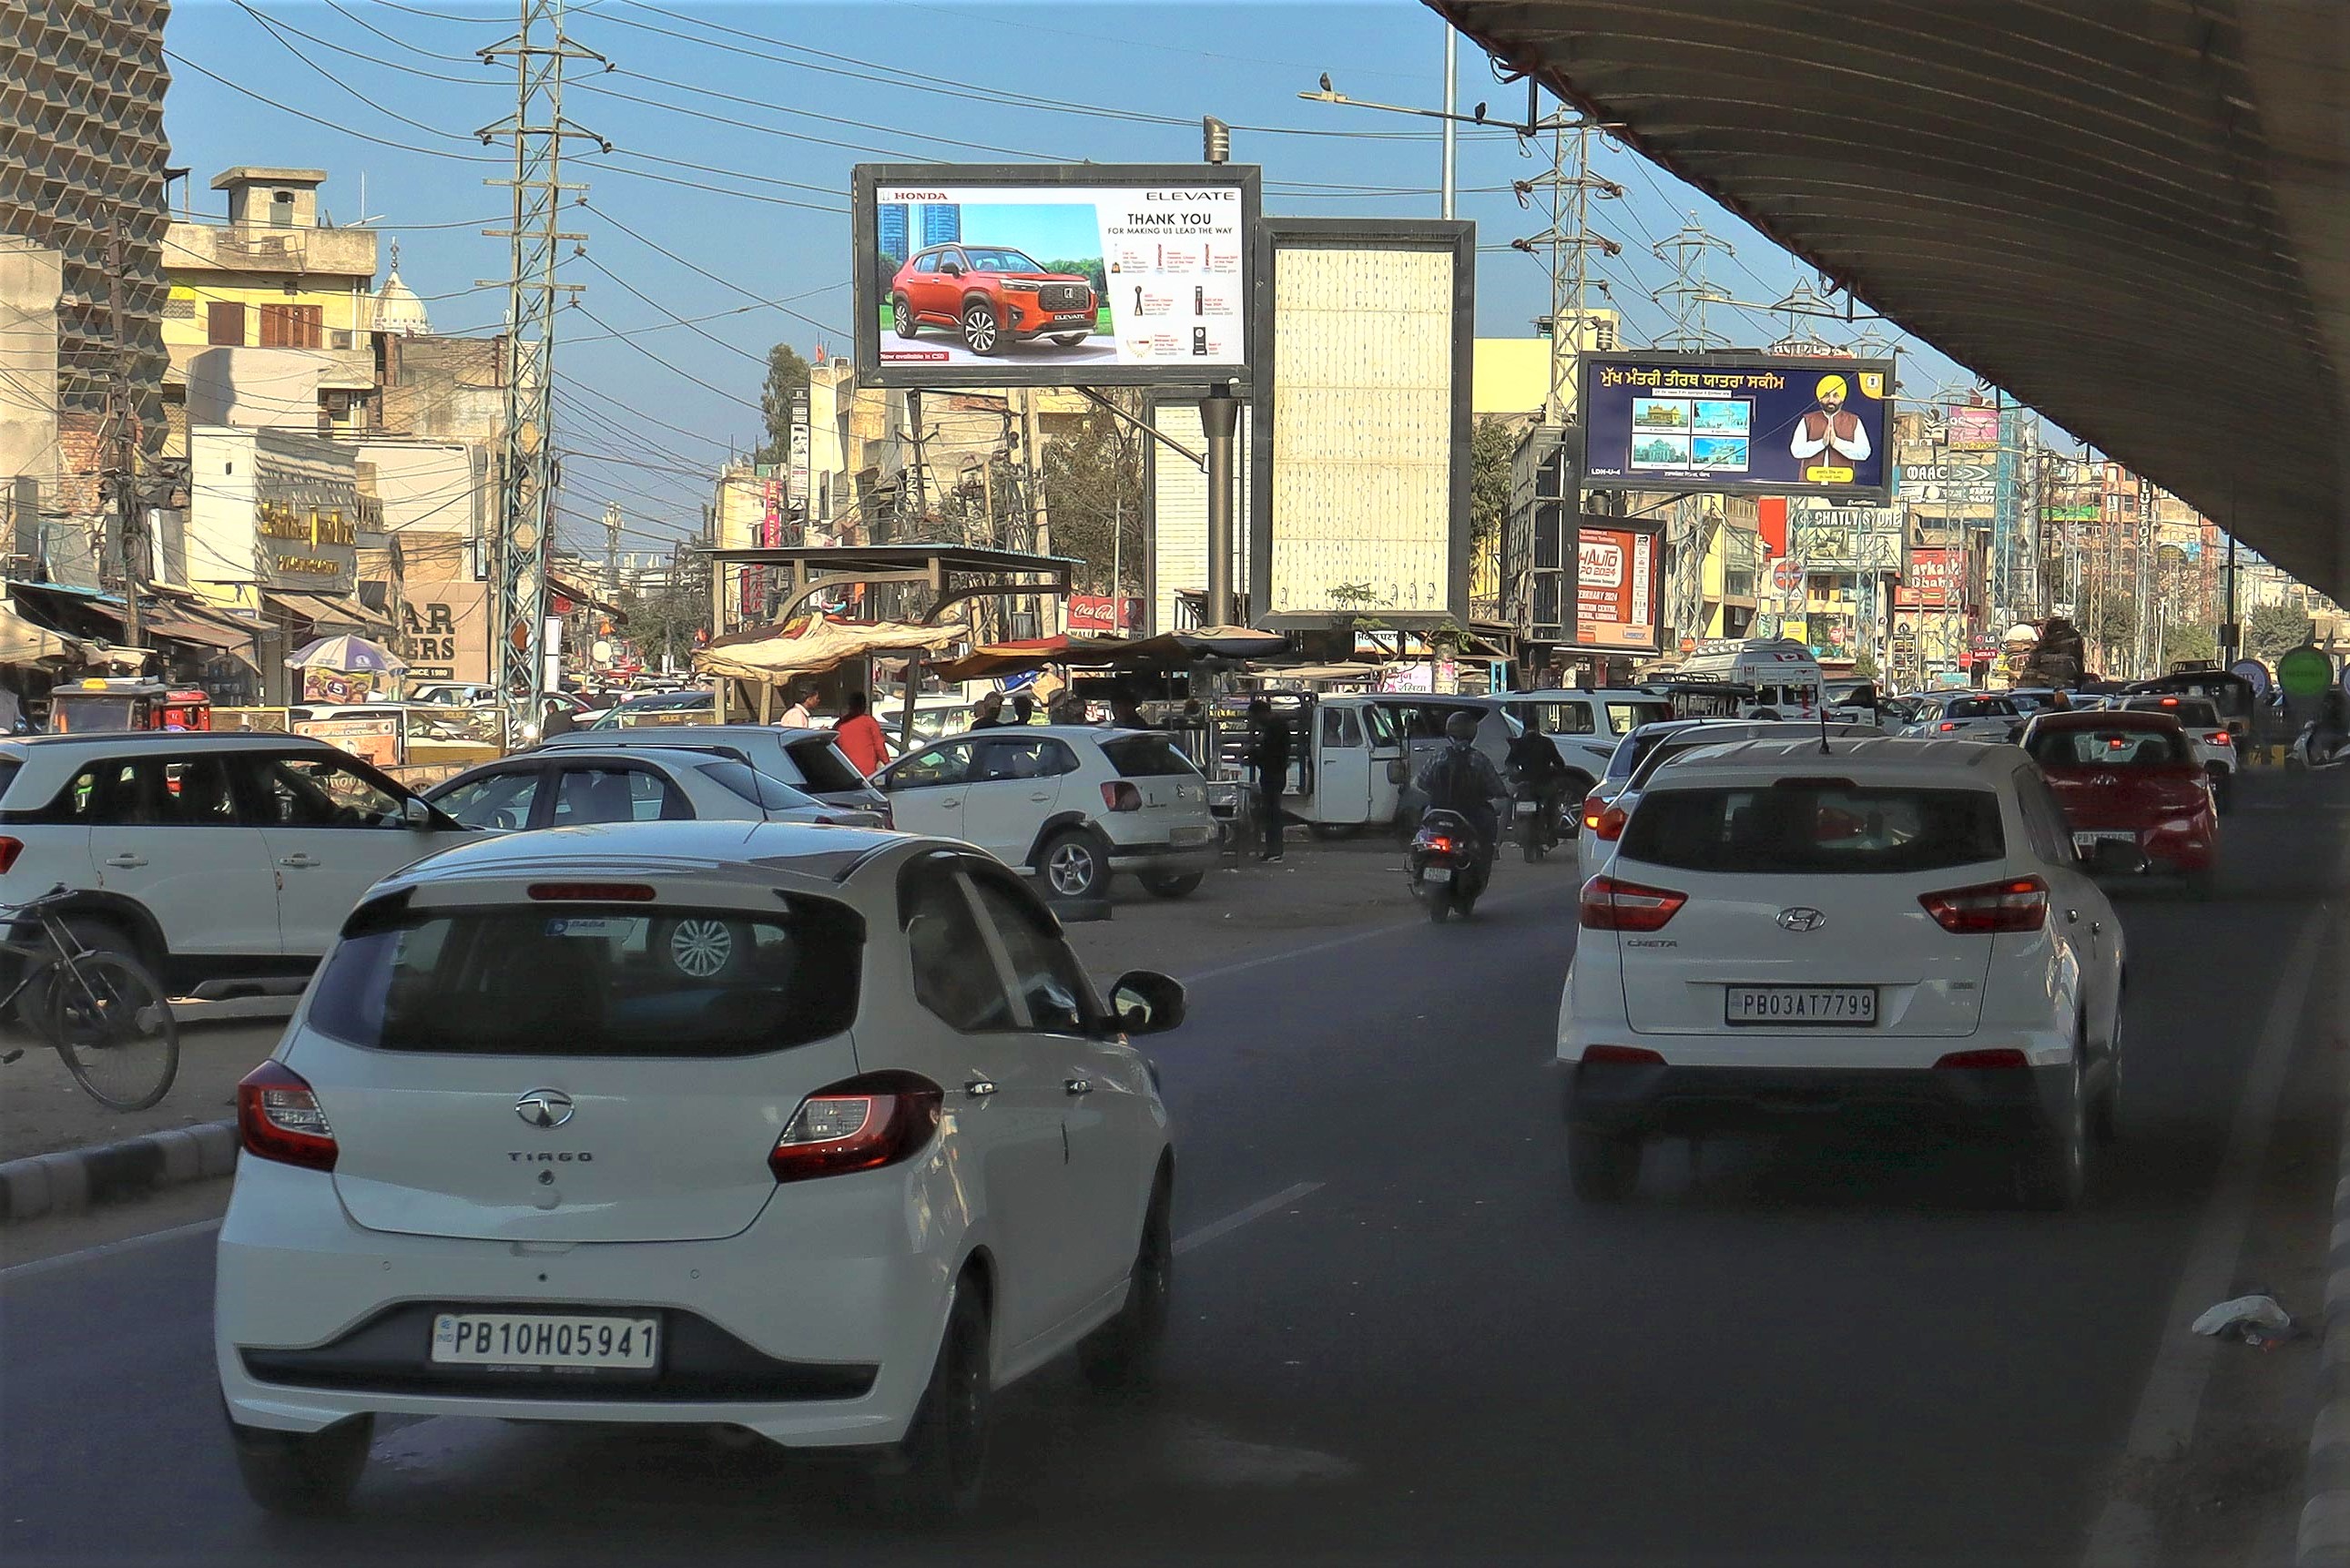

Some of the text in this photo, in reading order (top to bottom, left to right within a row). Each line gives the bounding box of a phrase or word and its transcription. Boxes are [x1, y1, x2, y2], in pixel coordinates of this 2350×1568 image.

[895, 192, 948, 200] HONDA
[1146, 191, 1236, 201] ELEVATE
[1127, 213, 1211, 225] THANK YOU
[1107, 227, 1124, 235] FOR
[1601, 367, 1785, 389] ਮੁੱਖ ਮੰਤਰੀ ਤੀਰਥ ਯਾਤਰਾ ਸਕੀਮ
[1907, 465, 1948, 481] MAAC
[1593, 567, 1616, 576] 2024
[1627, 940, 1678, 948] CRETA
[1744, 994, 1871, 1015] PB03AT7799
[508, 1152, 592, 1162] TIAGO
[456, 1321, 653, 1358] PB10HQ5941
